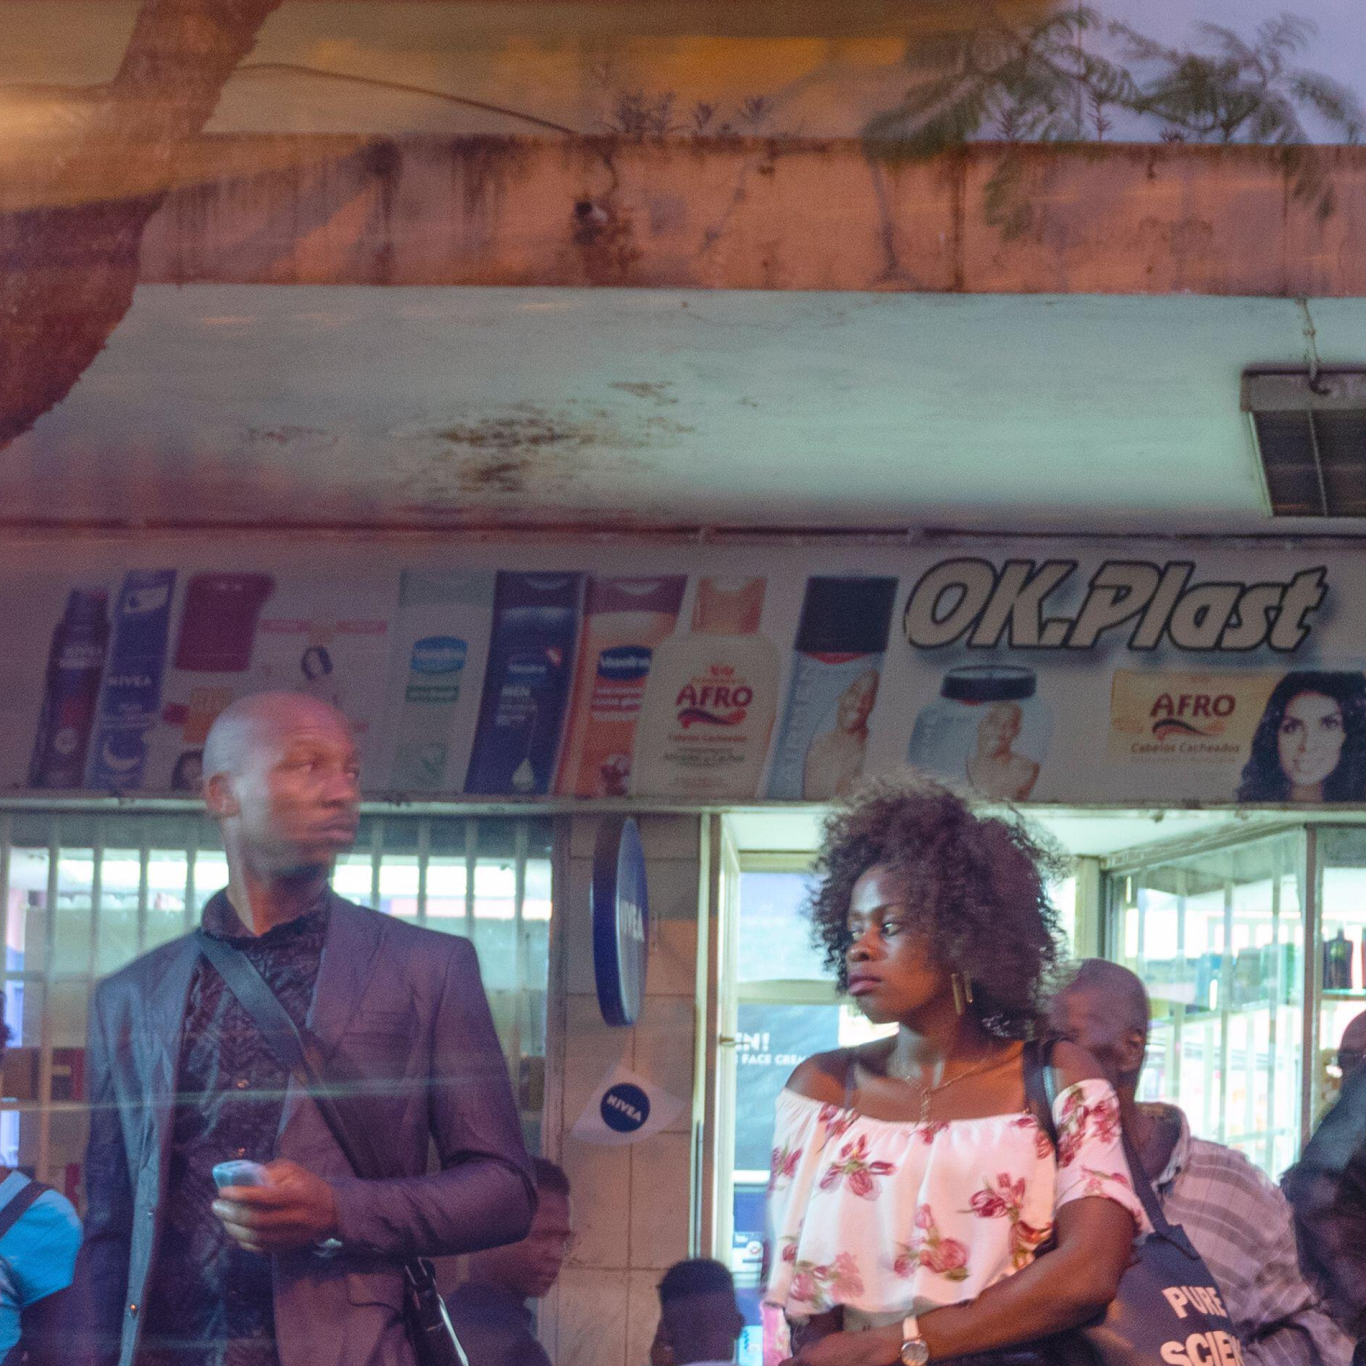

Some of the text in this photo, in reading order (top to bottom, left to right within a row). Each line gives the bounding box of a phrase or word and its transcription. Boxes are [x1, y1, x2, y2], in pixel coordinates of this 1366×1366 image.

[902, 556, 1328, 653] OK.Plast
[107, 675, 152, 687] NIVEA
[676, 684, 754, 708] AFRO
[1149, 692, 1237, 718] AFRO
[741, 1053, 772, 1065] FACE
[605, 1093, 643, 1123] NIVEA
[1161, 1284, 1228, 1319] PURE
